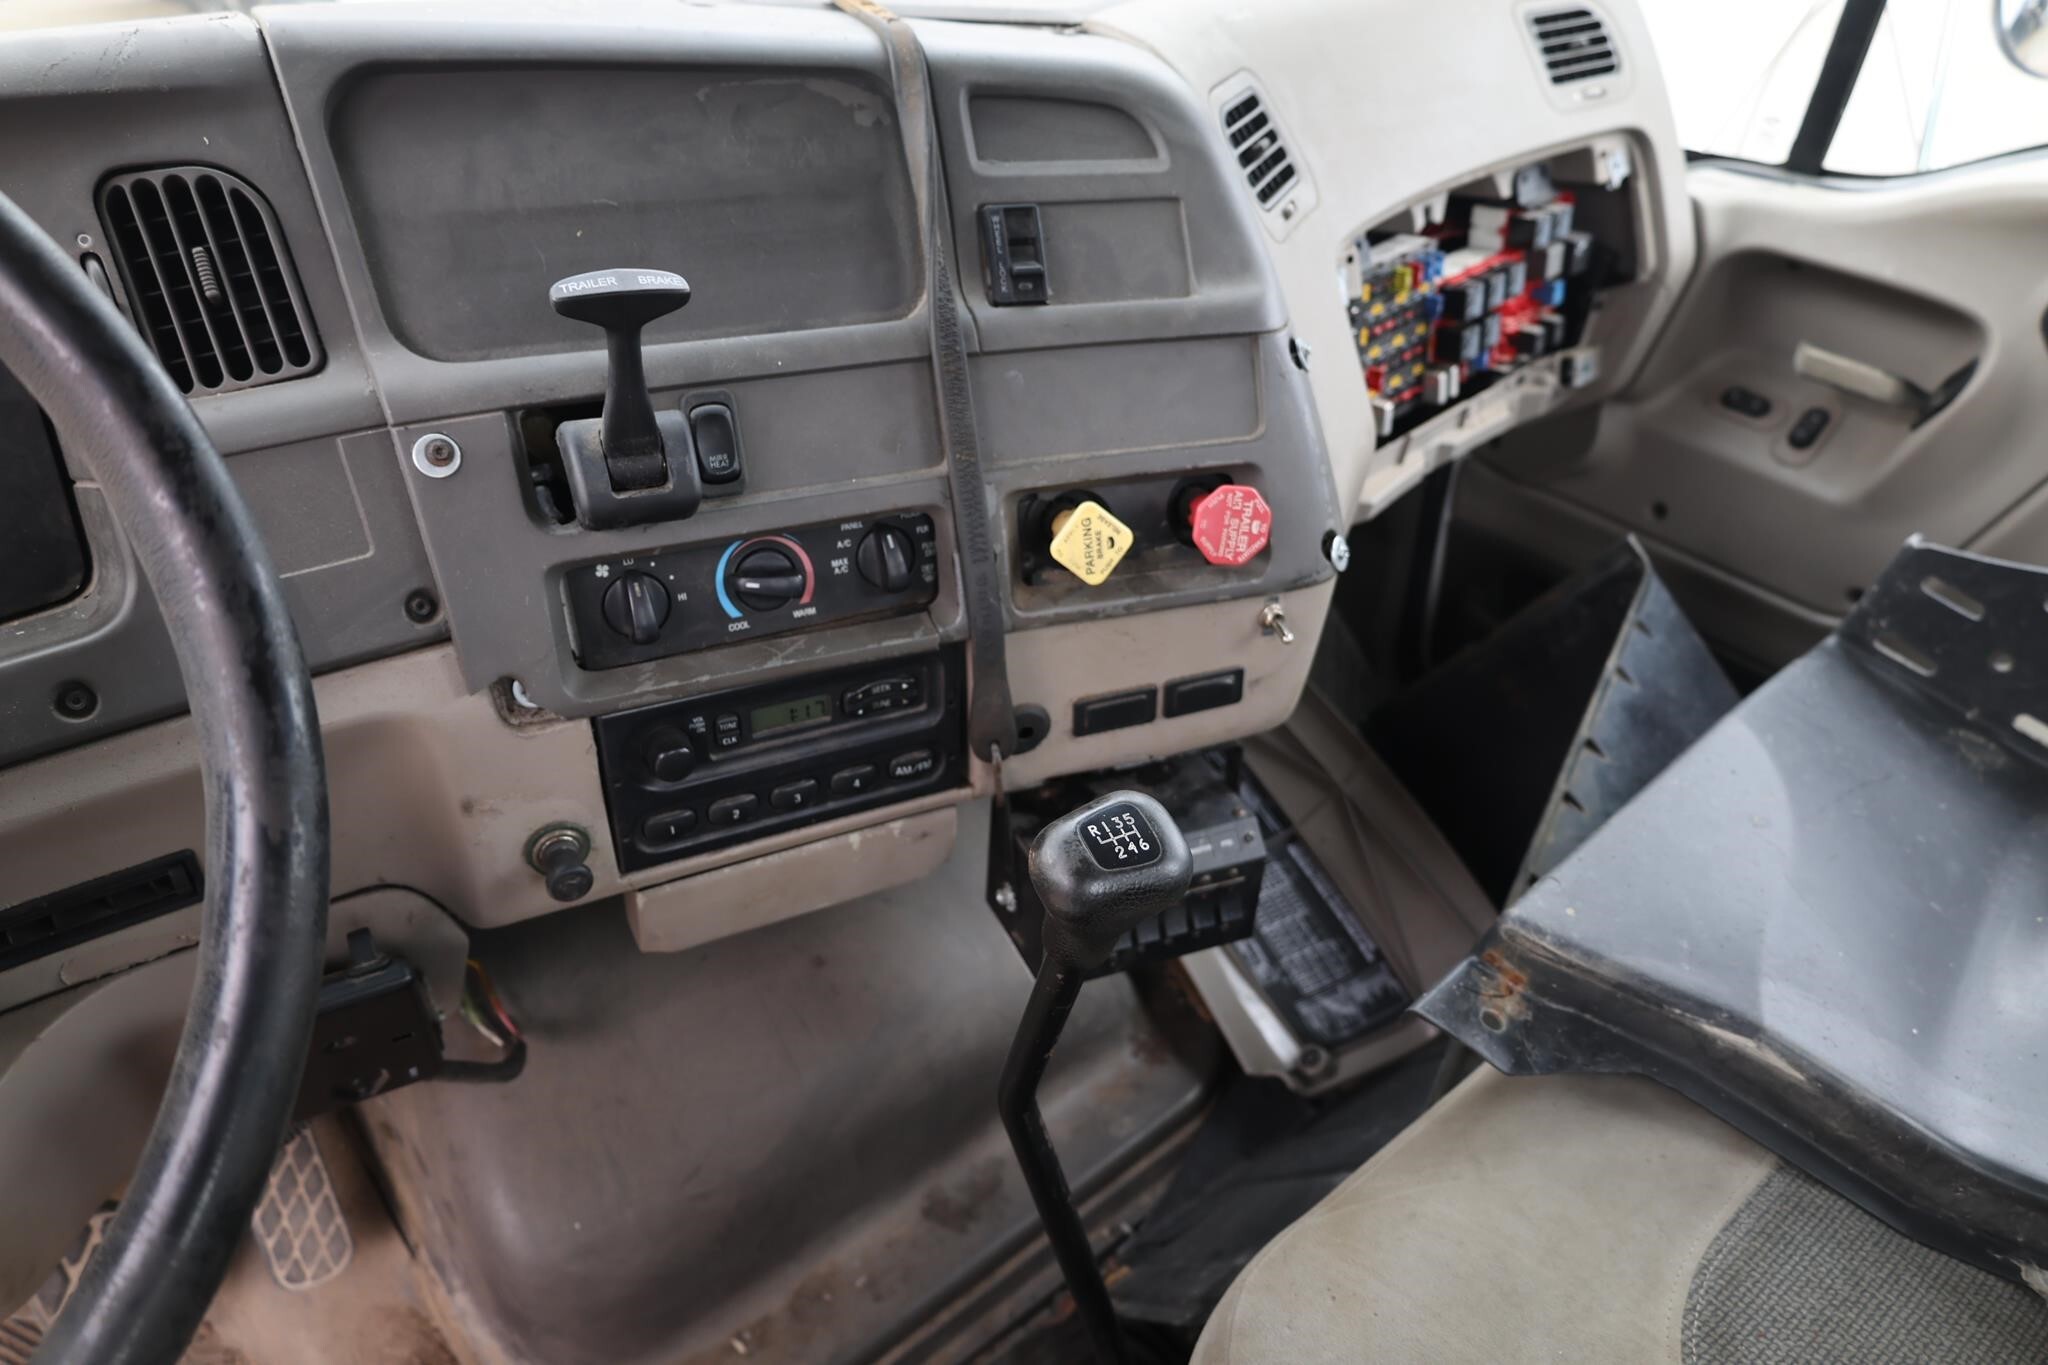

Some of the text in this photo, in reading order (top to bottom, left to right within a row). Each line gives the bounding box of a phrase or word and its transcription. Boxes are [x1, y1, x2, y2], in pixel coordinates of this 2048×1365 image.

[558, 275, 686, 294] TRAILER BRAKE
[1224, 490, 1244, 560] AIR SUPPLY
[1236, 500, 1254, 552] TRAILER
[1081, 517, 1095, 575] PARKING
[1095, 530, 1103, 559] BRAKE
[831, 557, 849, 568] MAX
[677, 592, 688, 602] HI
[792, 606, 817, 619] WARM
[728, 620, 751, 632] COOL
[895, 759, 932, 776] AM/FM
[853, 778, 860, 787] 4
[794, 793, 802, 803] 3
[732, 809, 740, 819] 2
[670, 825, 675, 835] 1
